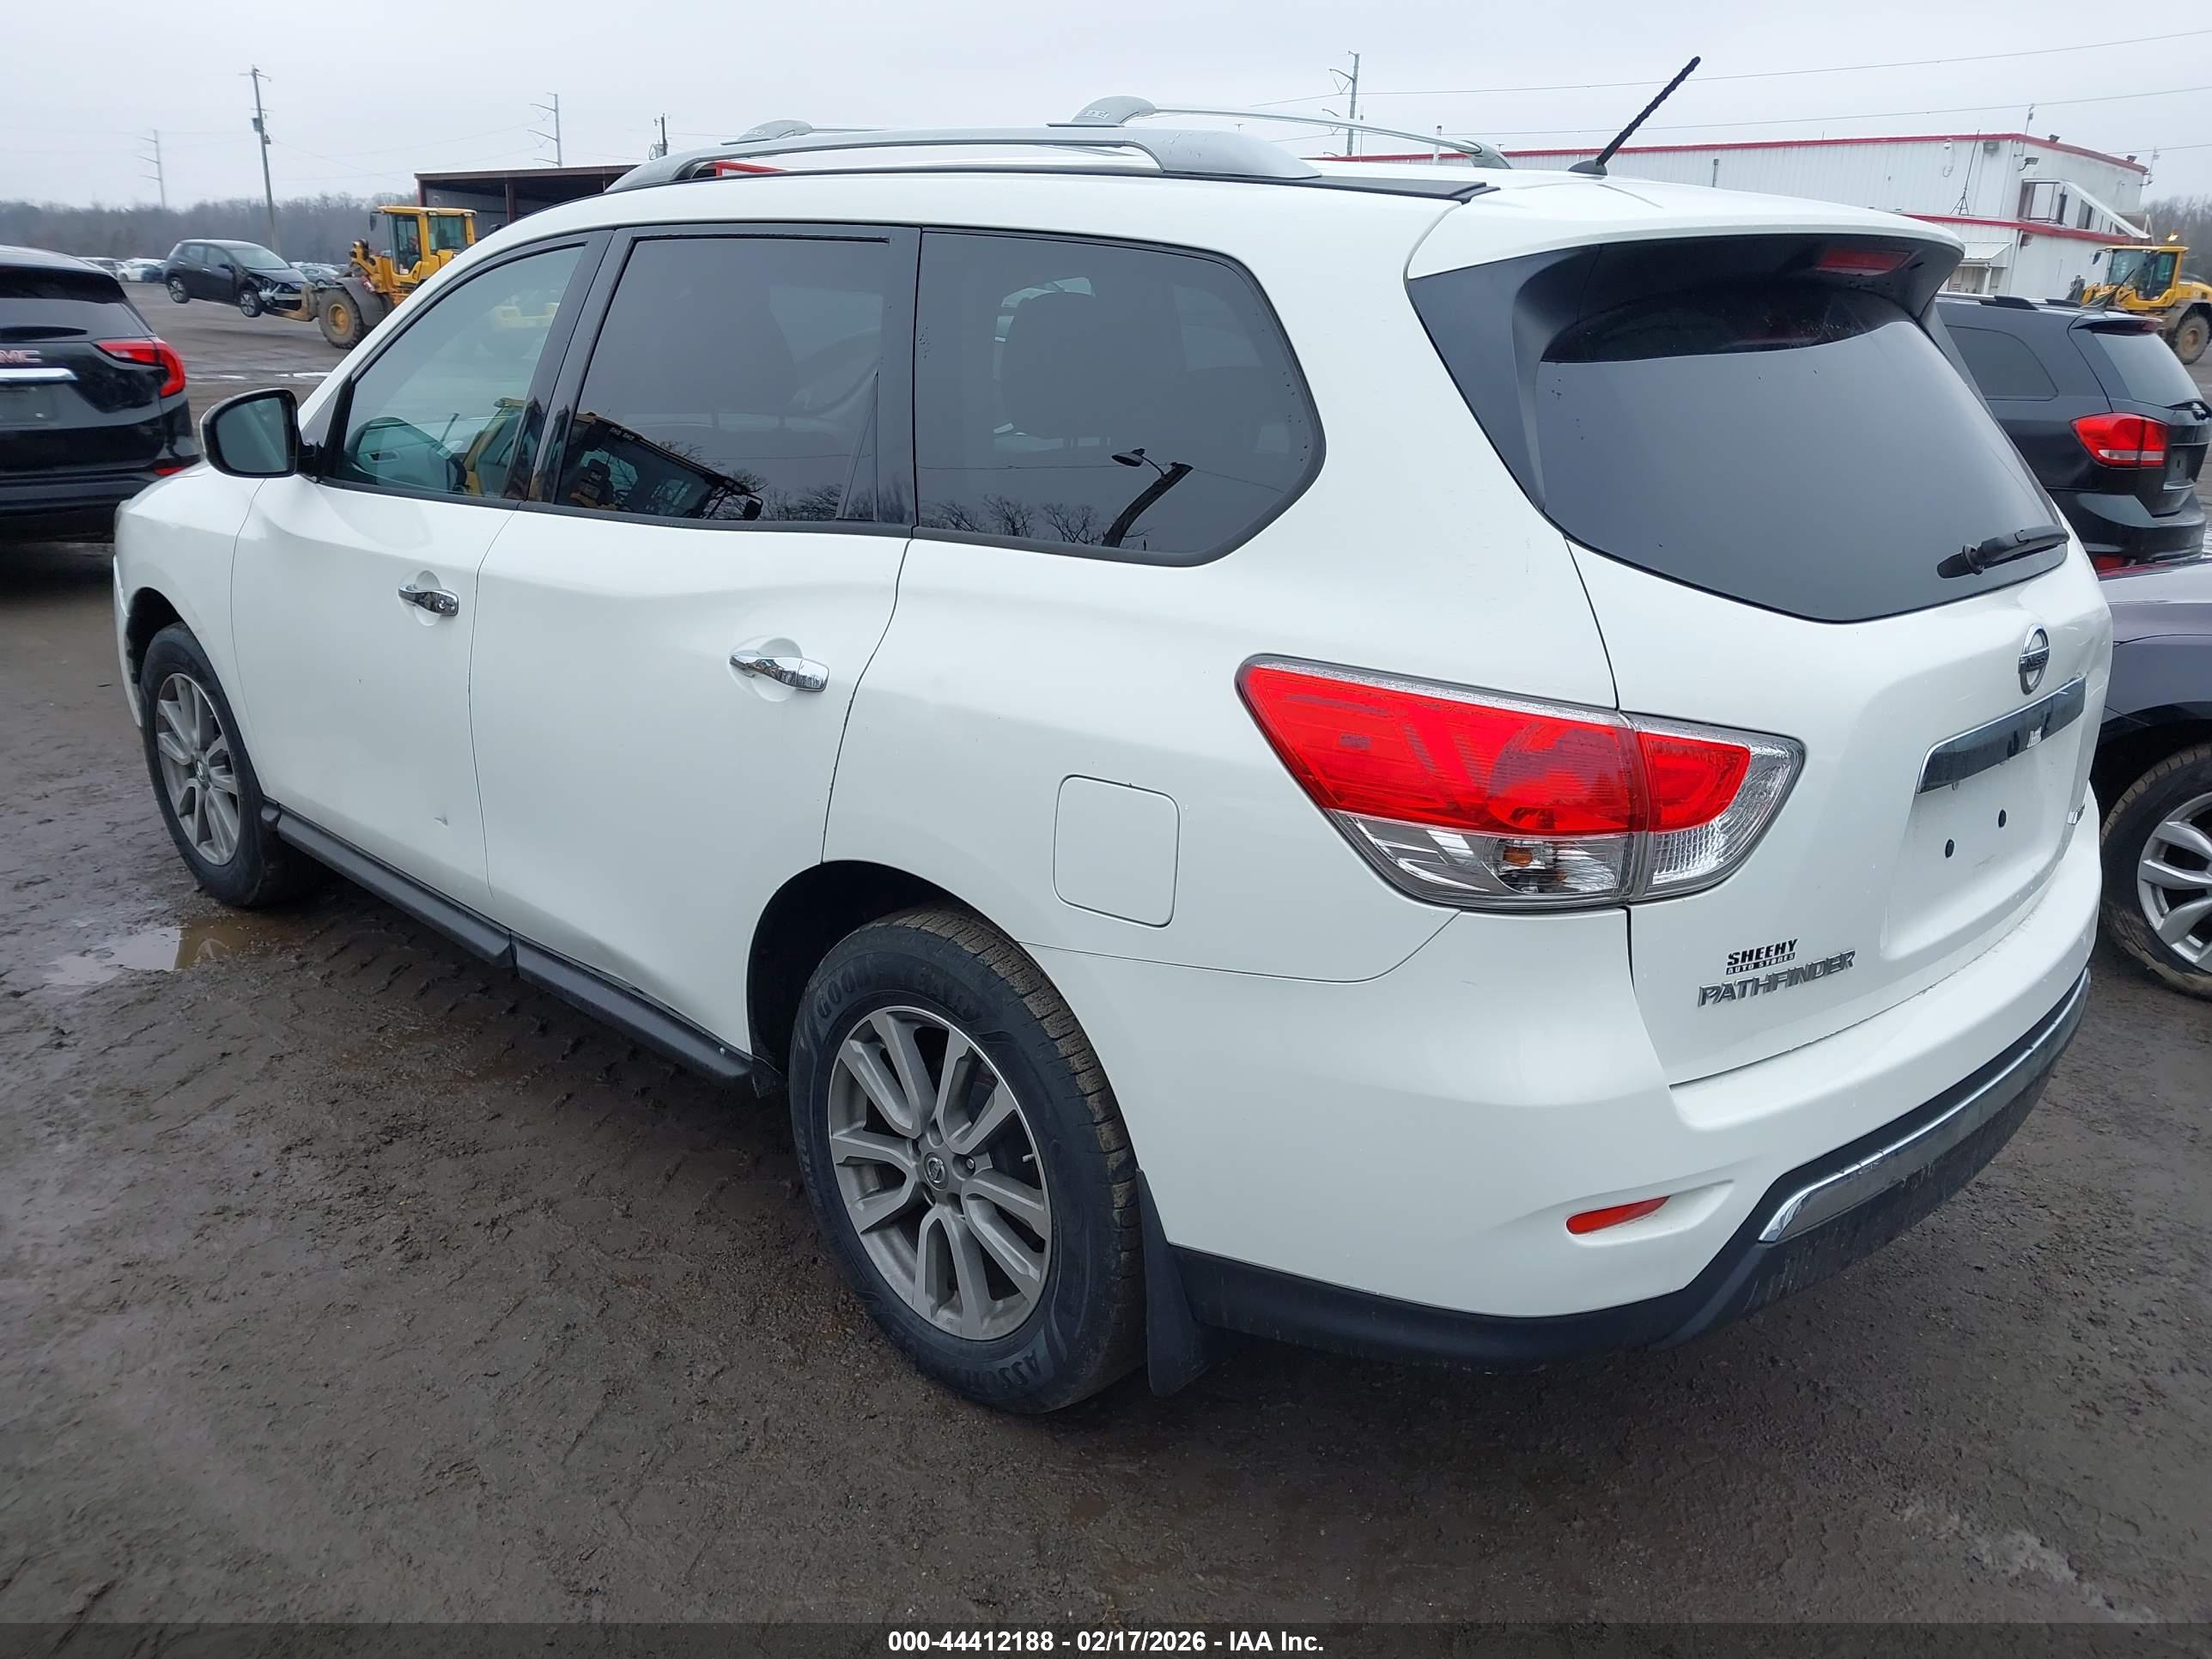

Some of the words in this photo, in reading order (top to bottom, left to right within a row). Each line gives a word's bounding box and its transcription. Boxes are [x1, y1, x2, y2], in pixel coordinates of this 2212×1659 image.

[0, 349, 42, 363] MC
[1727, 939, 1799, 966] SHEEHY
[1727, 963, 1755, 975] AUTO
[1758, 953, 1795, 968] STORES
[1697, 949, 1856, 1006] PATHFINDER
